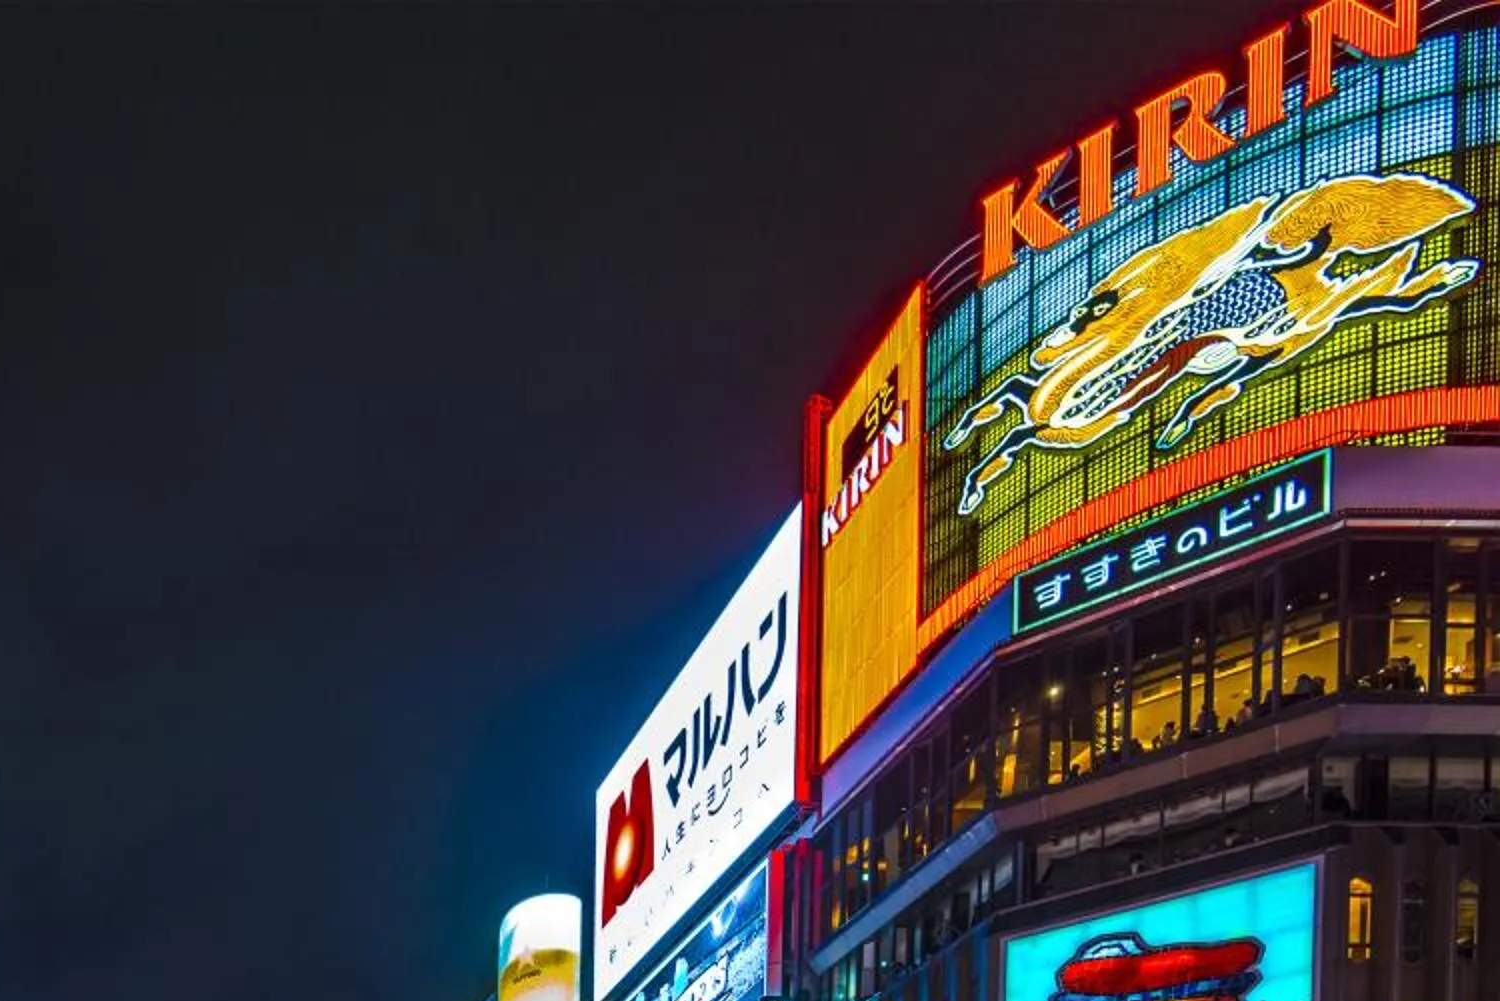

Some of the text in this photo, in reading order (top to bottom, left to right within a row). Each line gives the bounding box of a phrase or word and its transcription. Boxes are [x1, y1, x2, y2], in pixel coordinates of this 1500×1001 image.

[982, 0, 1417, 285] KIRIN
[821, 403, 906, 548] KIRIN
[1033, 480, 1308, 609] すすきのビル
[663, 591, 788, 806] マルハン
